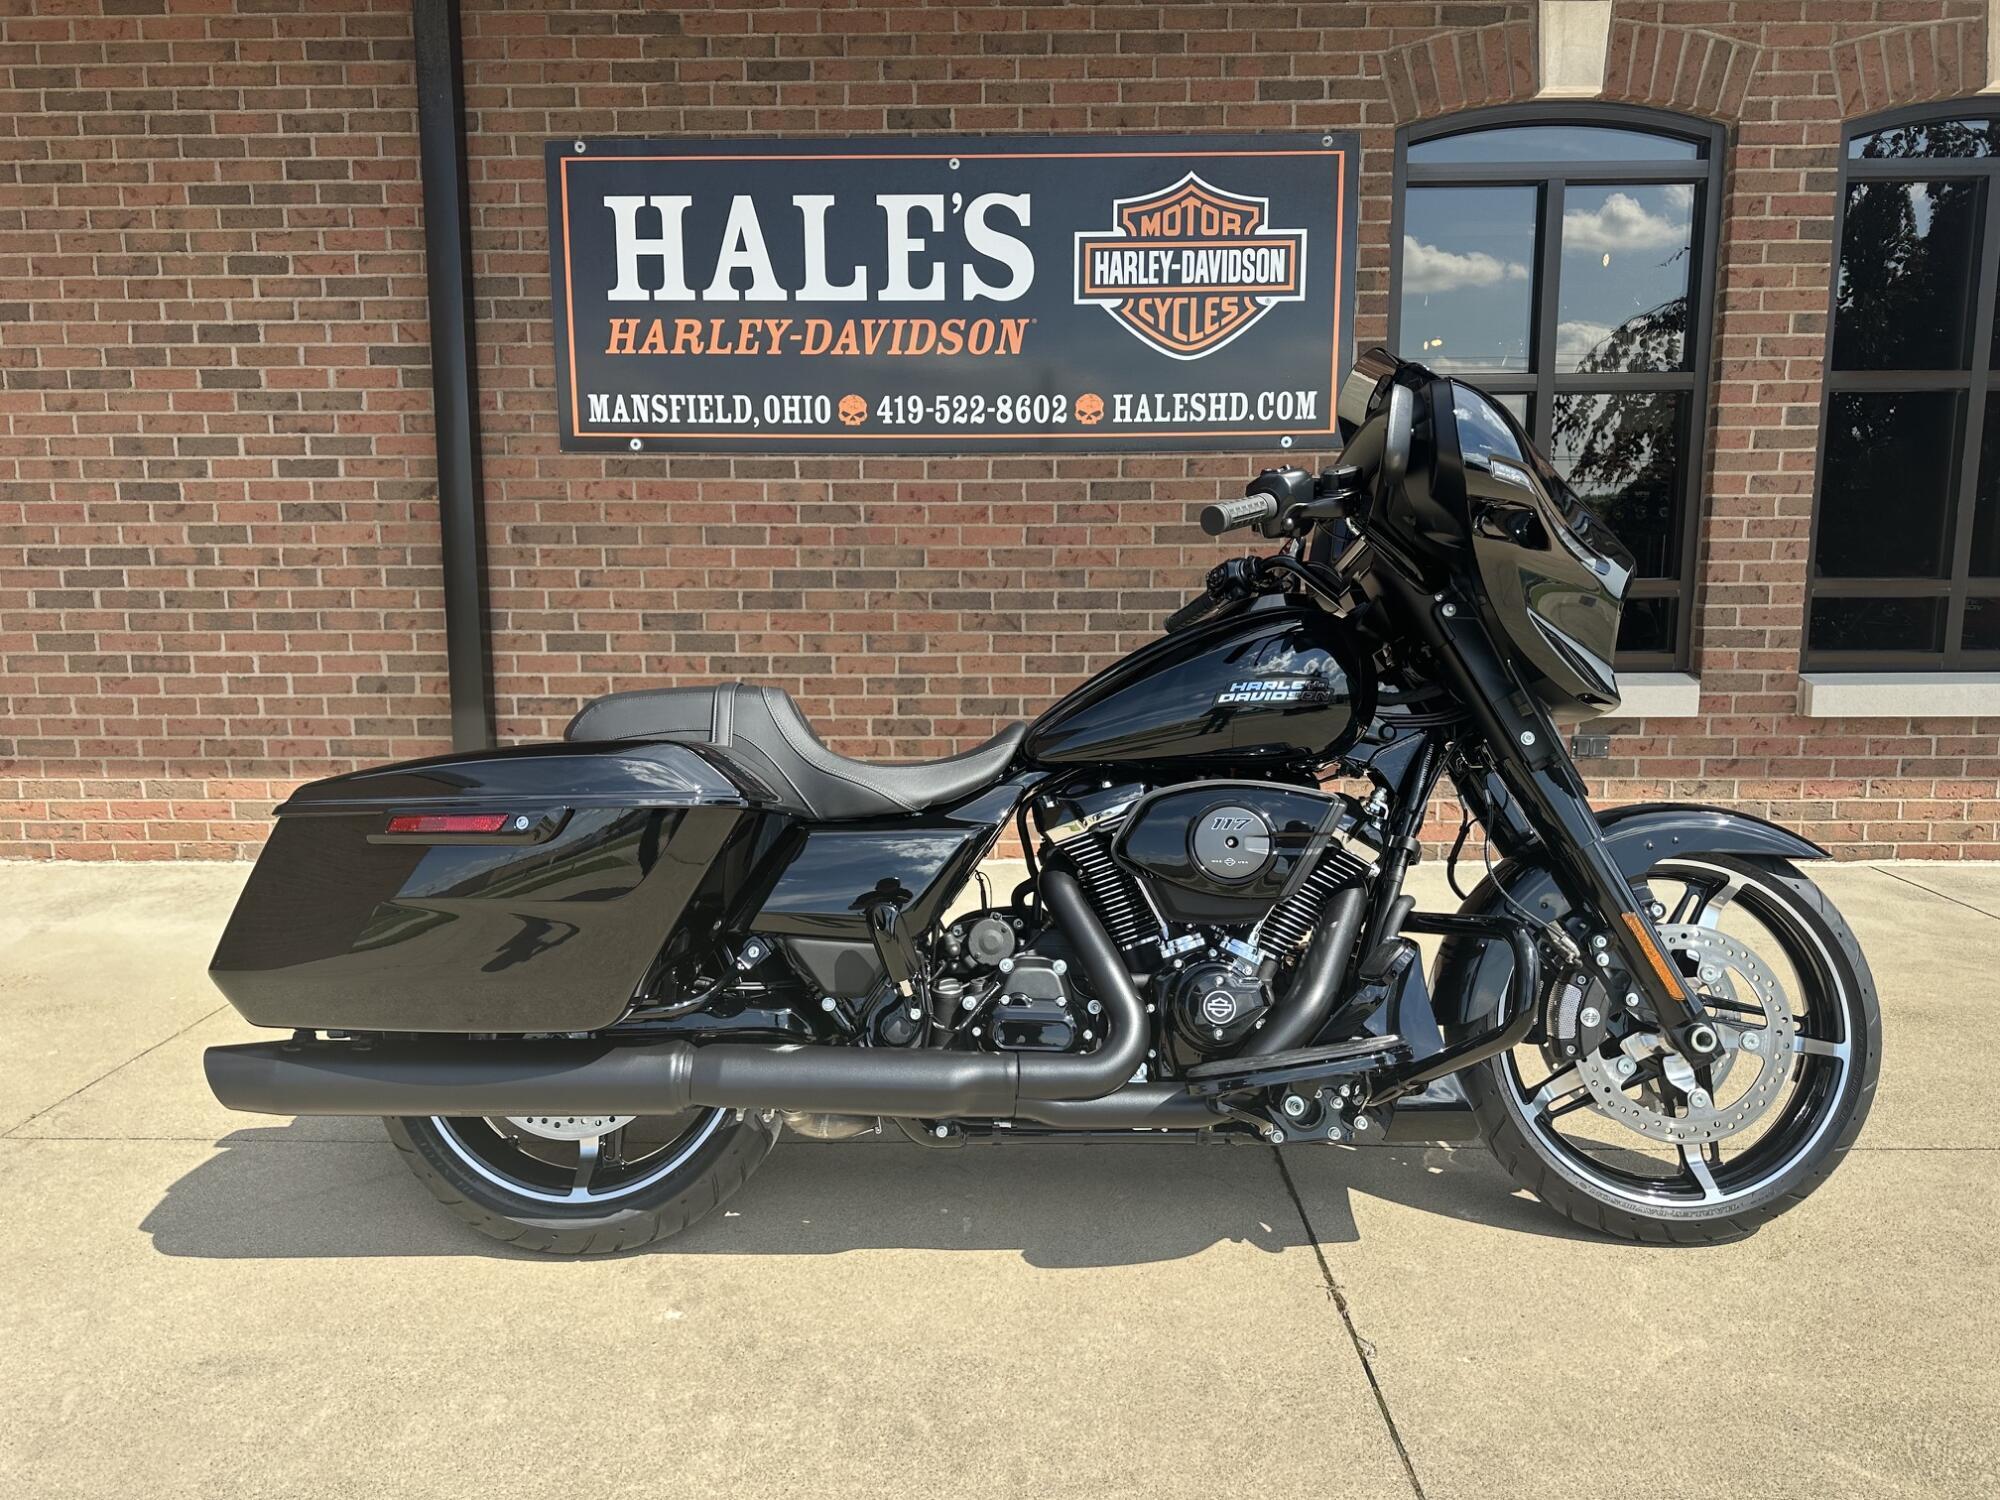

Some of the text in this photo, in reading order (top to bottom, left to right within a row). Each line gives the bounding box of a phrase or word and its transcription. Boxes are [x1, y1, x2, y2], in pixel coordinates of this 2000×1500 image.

[1141, 196, 1241, 236] MOTOR
[604, 193, 1034, 301] HALE'S
[1095, 248, 1285, 284] HARLEY-DAVIDSON
[607, 319, 1028, 355] HARLEY-DAVIDSON
[1139, 297, 1239, 341] CYCLES
[764, 395, 830, 424] OHIO
[877, 395, 1067, 424] 419-522-8602
[1113, 391, 1317, 422] HALESHD.COM
[1211, 816, 1253, 831] 117
